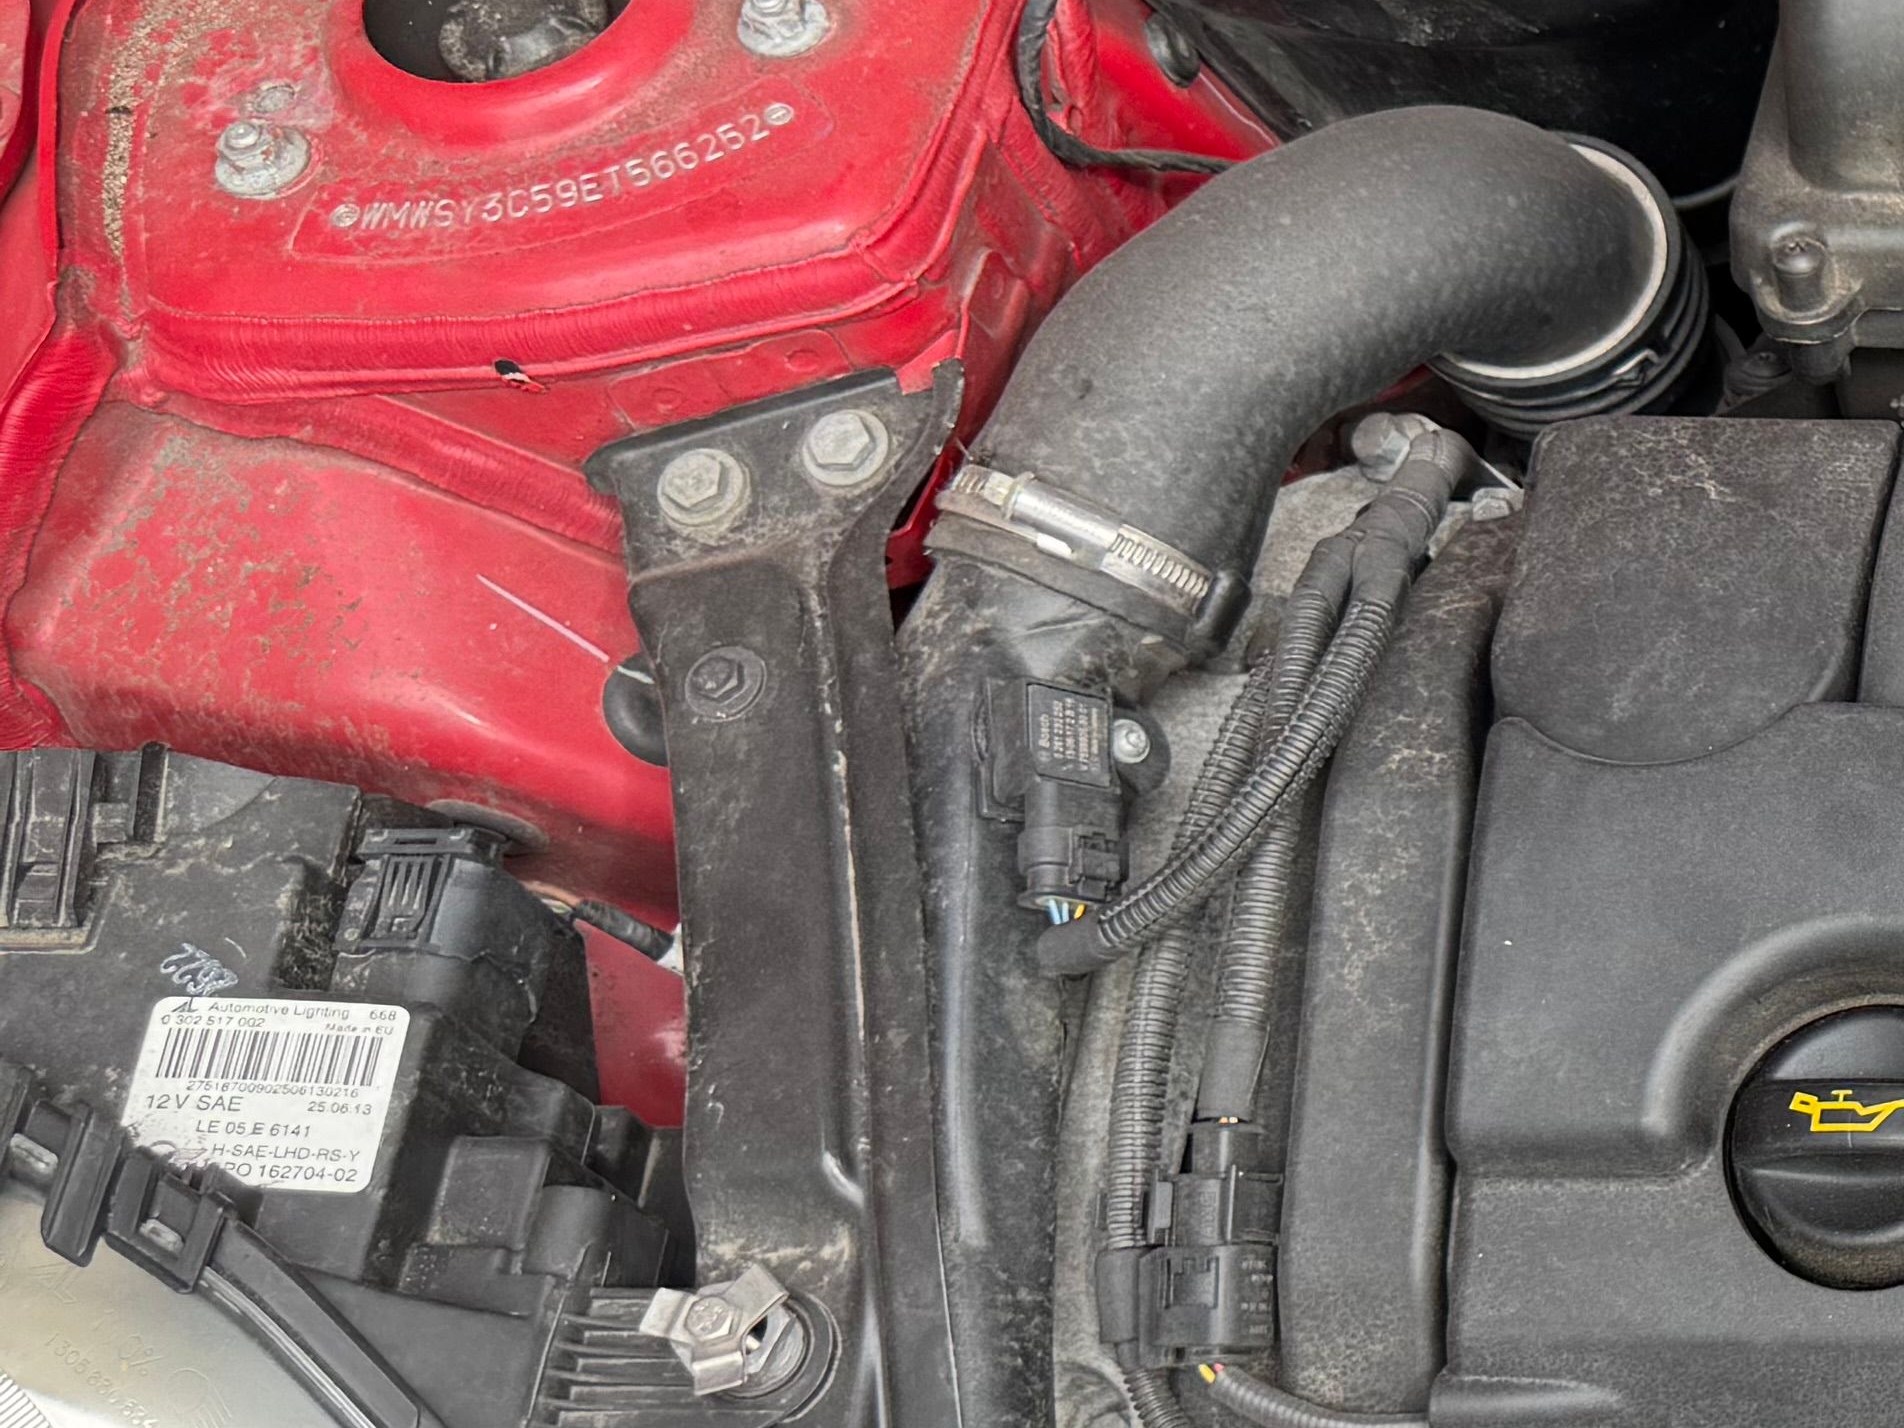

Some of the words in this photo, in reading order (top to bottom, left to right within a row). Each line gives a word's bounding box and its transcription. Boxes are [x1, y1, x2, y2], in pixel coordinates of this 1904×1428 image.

[361, 113, 769, 230] WMWSY3C59ET566252
[208, 1001, 289, 1016] Automotive
[293, 1005, 350, 1021] Lighting
[369, 1009, 397, 1021] 668
[161, 1015, 171, 1024] 0
[175, 1015, 201, 1026] 302
[205, 1016, 235, 1026] 517
[238, 1017, 266, 1028] 002
[375, 1025, 395, 1036] EU
[196, 1095, 243, 1112] SAE
[196, 1120, 220, 1134] LE
[225, 1121, 246, 1135] 05
[251, 1123, 264, 1136] E
[270, 1123, 311, 1138] 6141
[211, 1143, 360, 1163] H-SAE-LHD-RS-Y
[258, 1163, 358, 1183] 162704-02
